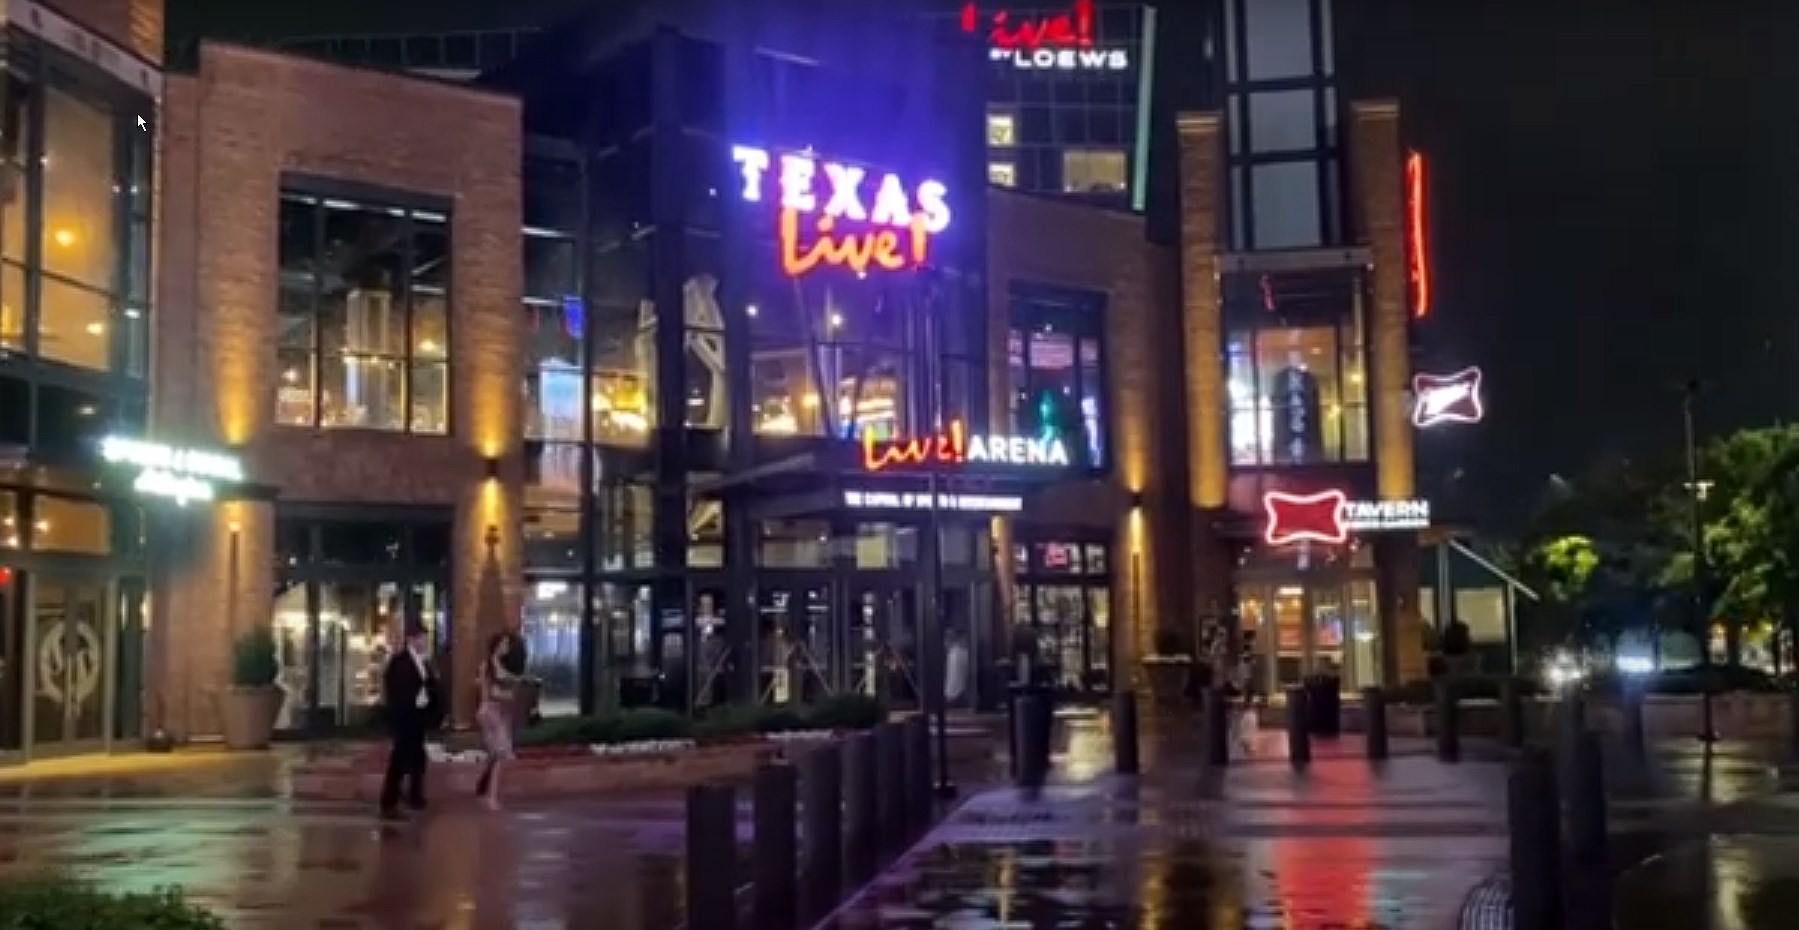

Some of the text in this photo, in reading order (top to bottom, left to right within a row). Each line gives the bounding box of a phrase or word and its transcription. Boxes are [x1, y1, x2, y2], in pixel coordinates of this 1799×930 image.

[1014, 49, 1128, 68] LOEWS
[732, 146, 950, 233] TEXAS
[780, 207, 928, 275] Live!
[967, 435, 1069, 465] ARENA
[1345, 500, 1430, 518] TAVERN
